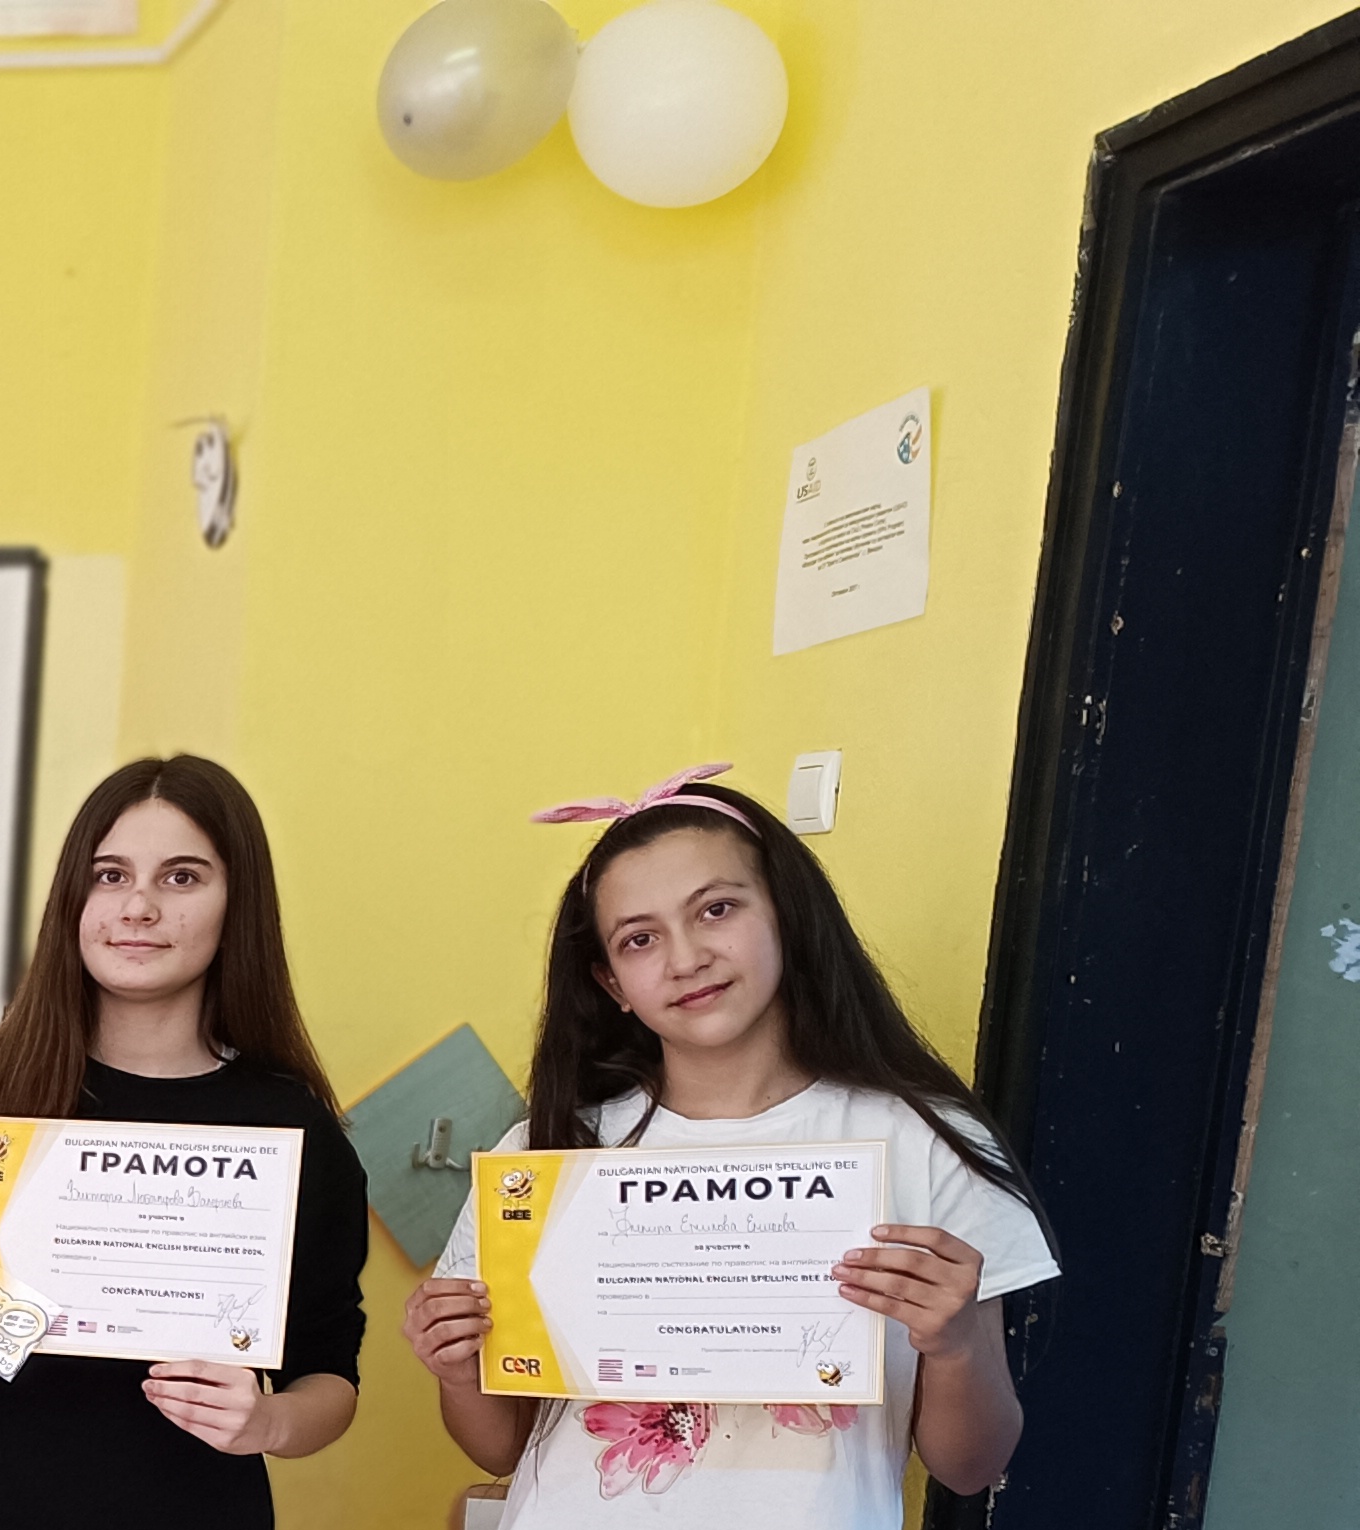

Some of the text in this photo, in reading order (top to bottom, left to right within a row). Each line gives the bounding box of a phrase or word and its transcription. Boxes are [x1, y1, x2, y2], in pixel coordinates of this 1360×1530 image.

[64, 1138, 278, 1154] BULGARIAN NATIONAL ENGLISH SPELLING BEE
[80, 1151, 257, 1180] ГРАМОТА
[598, 1160, 857, 1176] BULGARIAN NATIONAL ENGLISH SPELLING BEE
[619, 1175, 834, 1203] ГРАМОТА
[101, 1286, 204, 1299] CONGRATULATIONS!
[658, 1325, 781, 1334] CONGRATULATIONS!
